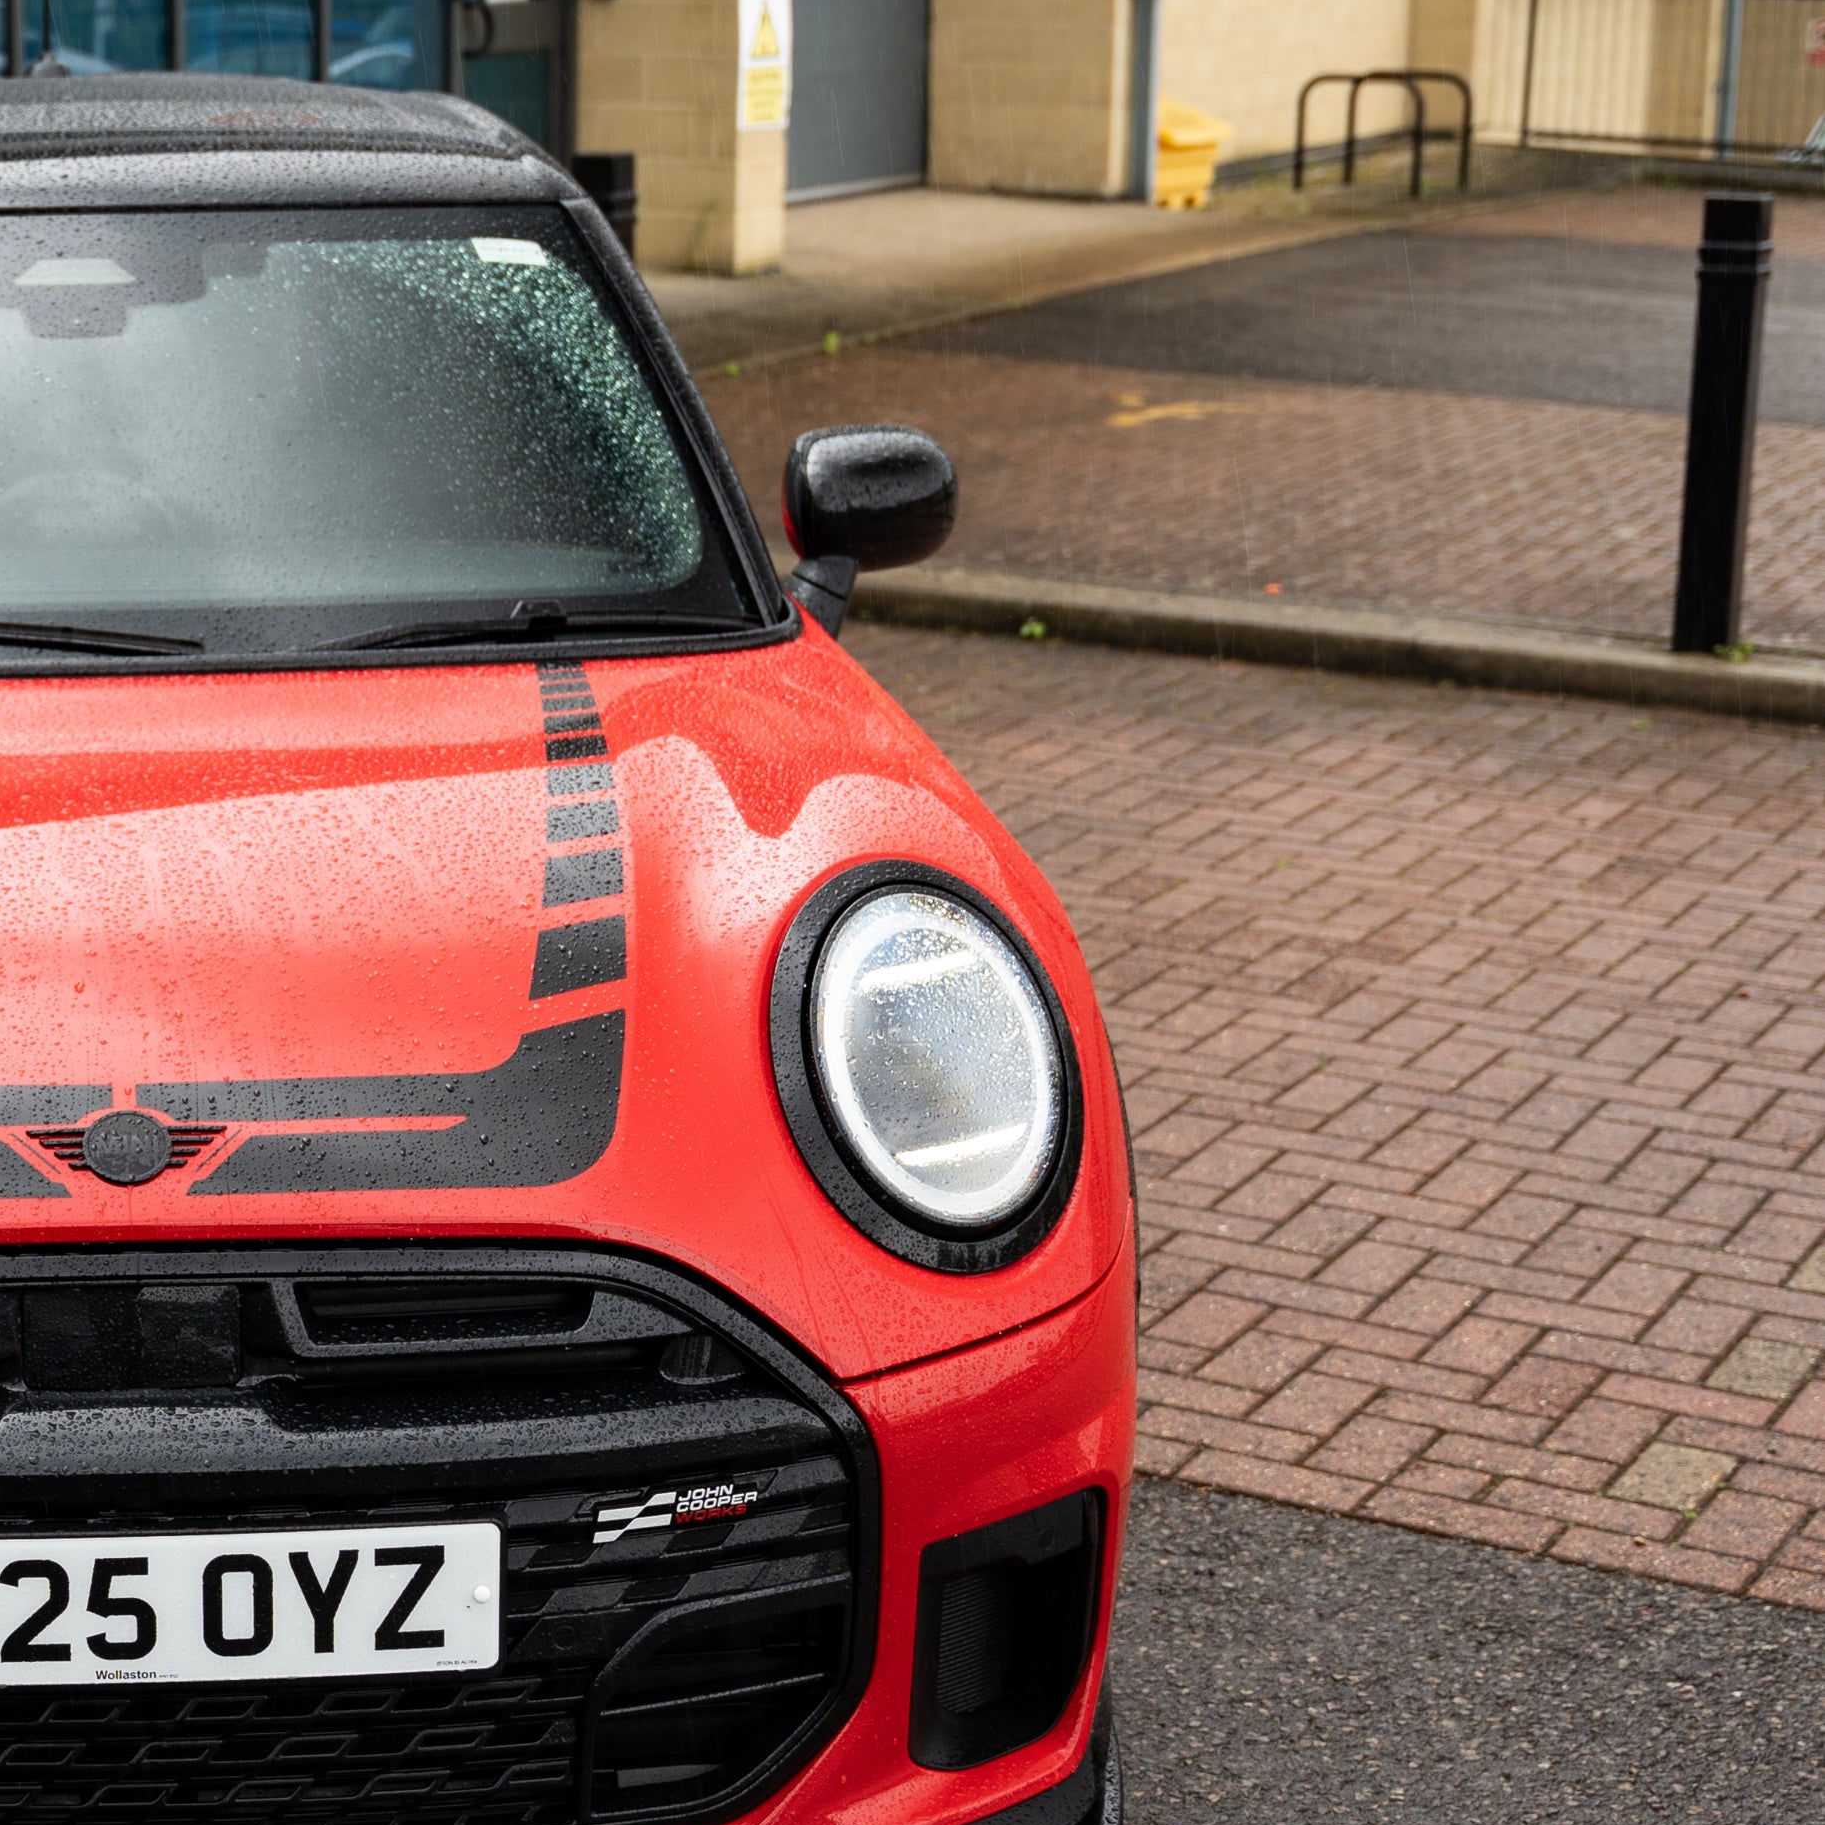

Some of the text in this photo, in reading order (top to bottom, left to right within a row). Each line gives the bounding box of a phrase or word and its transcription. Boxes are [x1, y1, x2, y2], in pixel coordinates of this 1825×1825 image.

[676, 1491, 759, 1513] COOPER
[678, 1484, 735, 1502] JOHN
[675, 1504, 748, 1524] WORKS
[202, 1544, 445, 1657] OYZ
[95, 1670, 157, 1680] Wollaston
